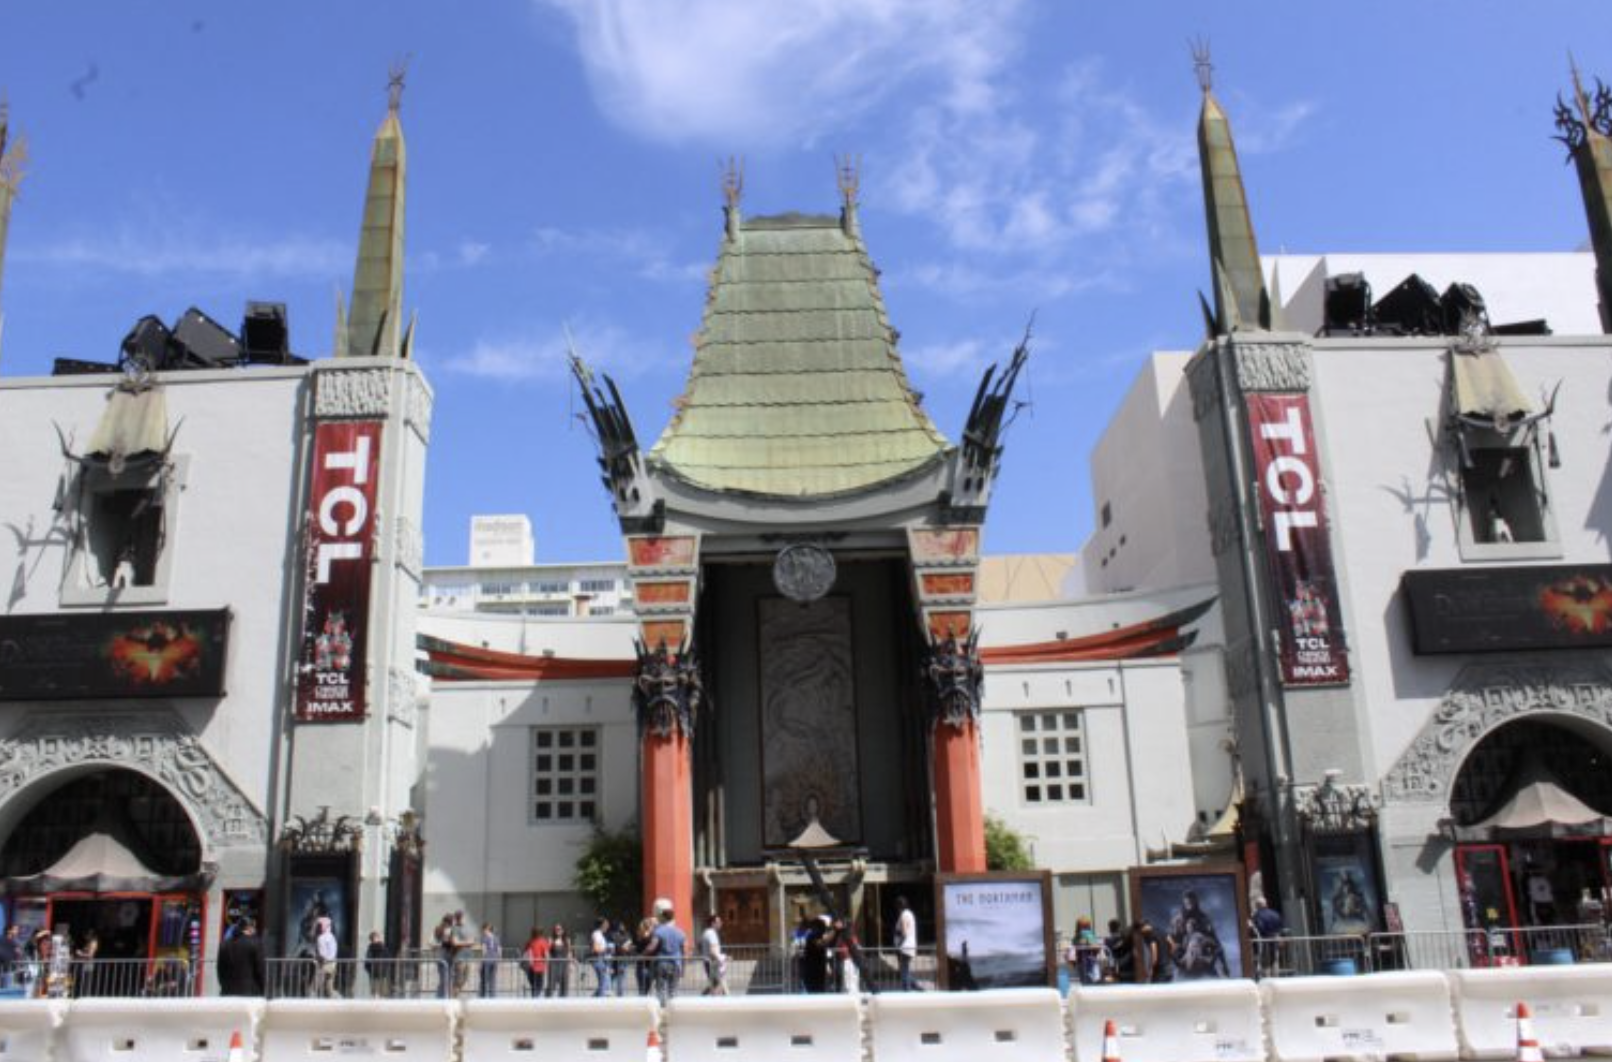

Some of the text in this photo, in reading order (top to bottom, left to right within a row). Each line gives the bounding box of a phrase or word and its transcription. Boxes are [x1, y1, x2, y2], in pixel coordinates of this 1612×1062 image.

[1260, 407, 1318, 551] TCL
[315, 435, 371, 583] TCL
[1296, 637, 1331, 650] TCL
[315, 672, 350, 684] TCL
[1292, 665, 1338, 678] IMAX
[306, 700, 354, 712] IMAX
[956, 892, 973, 905] THE
